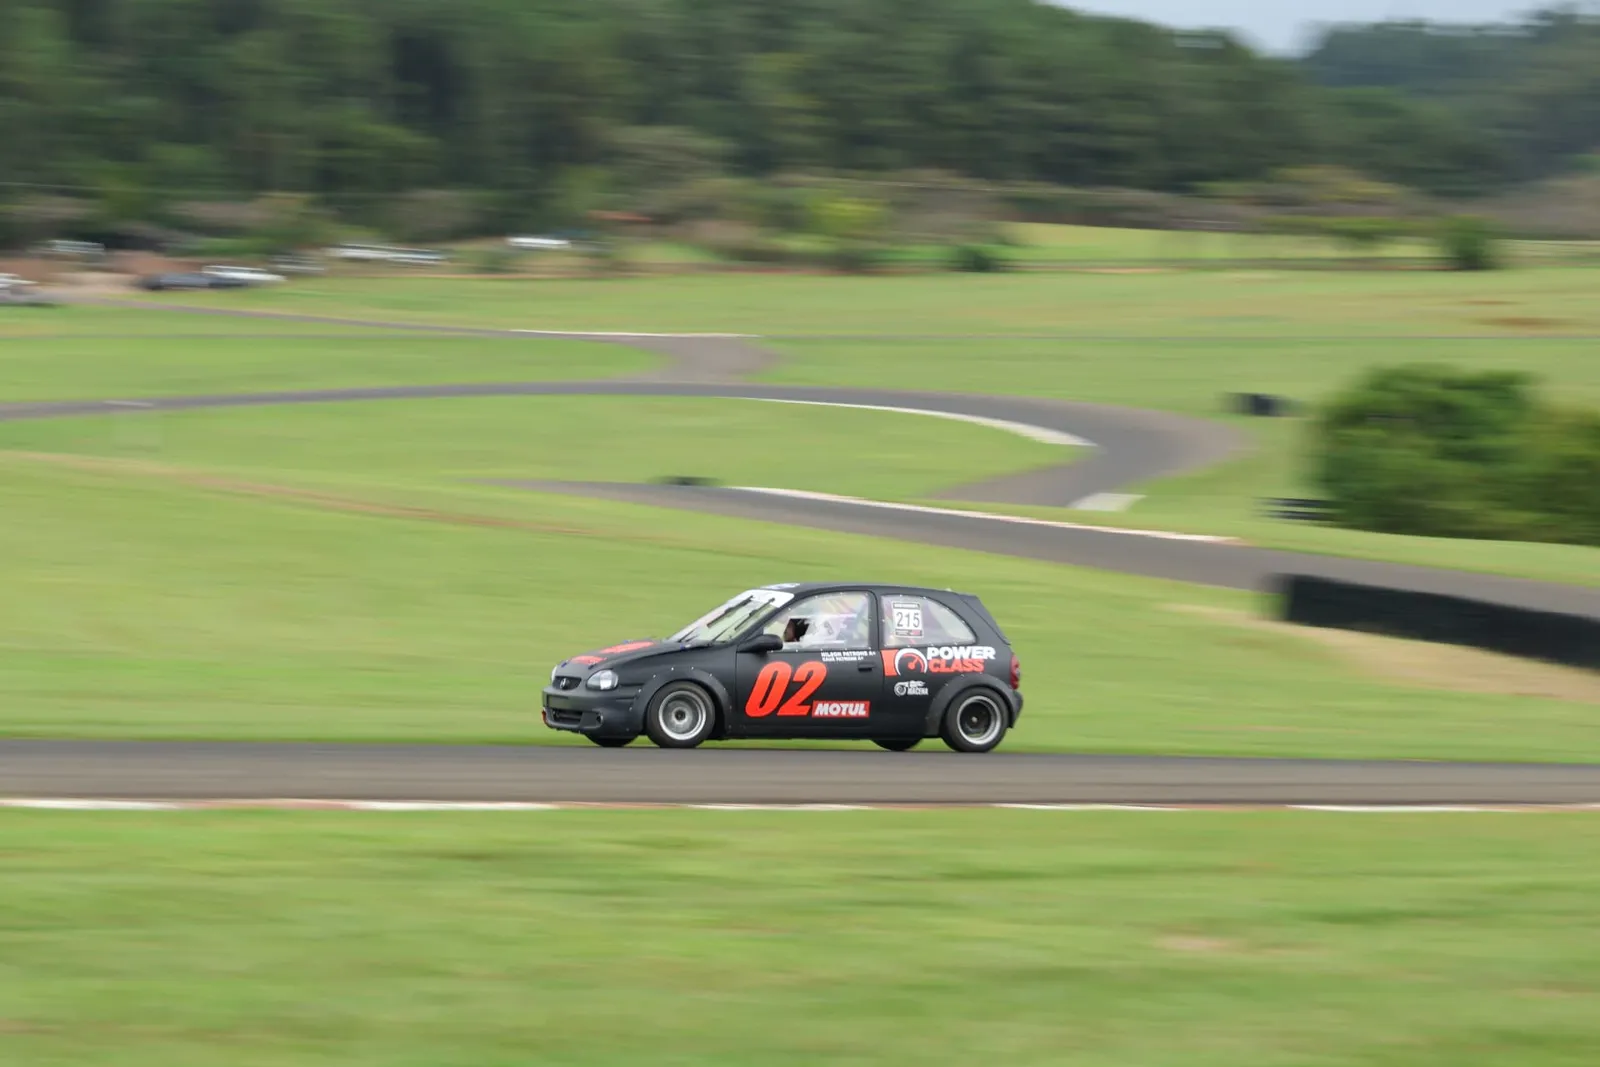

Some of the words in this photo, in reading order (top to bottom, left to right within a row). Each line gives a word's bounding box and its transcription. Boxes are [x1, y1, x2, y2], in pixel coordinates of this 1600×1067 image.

[896, 612, 920, 628] 215
[927, 646, 996, 660] POWER
[928, 659, 985, 673] CLASS
[745, 661, 827, 717] 02
[814, 703, 866, 716] MOTUL
